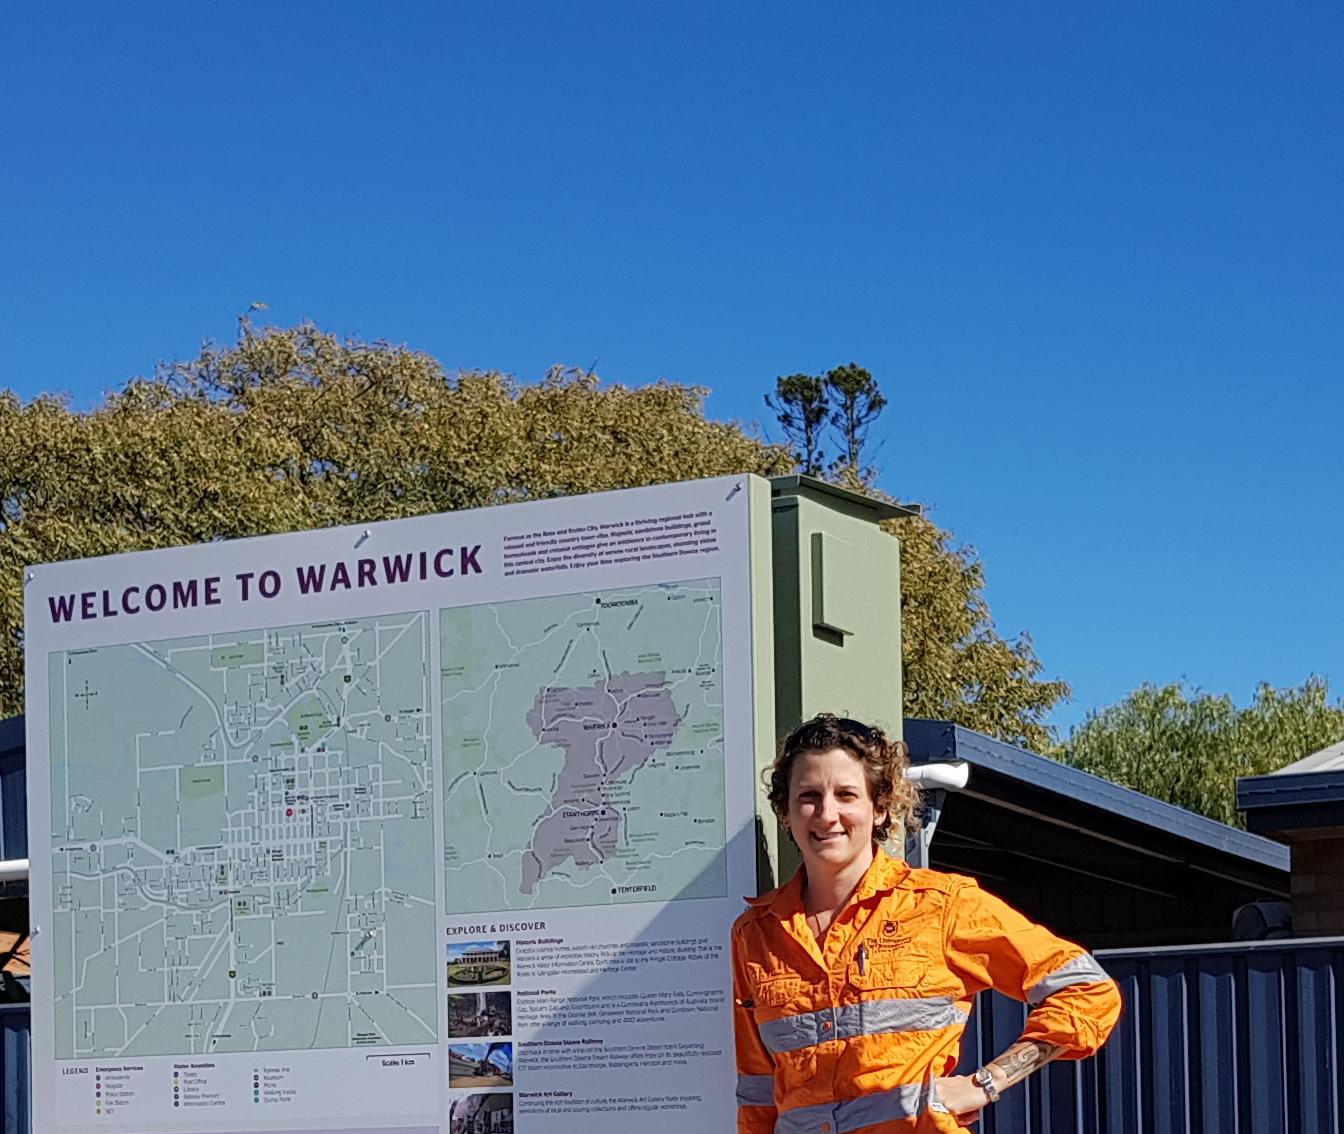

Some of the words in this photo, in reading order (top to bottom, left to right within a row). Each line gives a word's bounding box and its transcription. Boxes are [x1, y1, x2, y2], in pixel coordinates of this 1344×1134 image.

[48, 576, 223, 624] WELCOME
[235, 569, 282, 602] TO
[295, 544, 484, 596] WARWICK
[618, 885, 657, 894] TENTERFIELD
[446, 925, 488, 936] EXPLORE
[490, 924, 497, 934] &
[499, 921, 546, 933] DISCOVER
